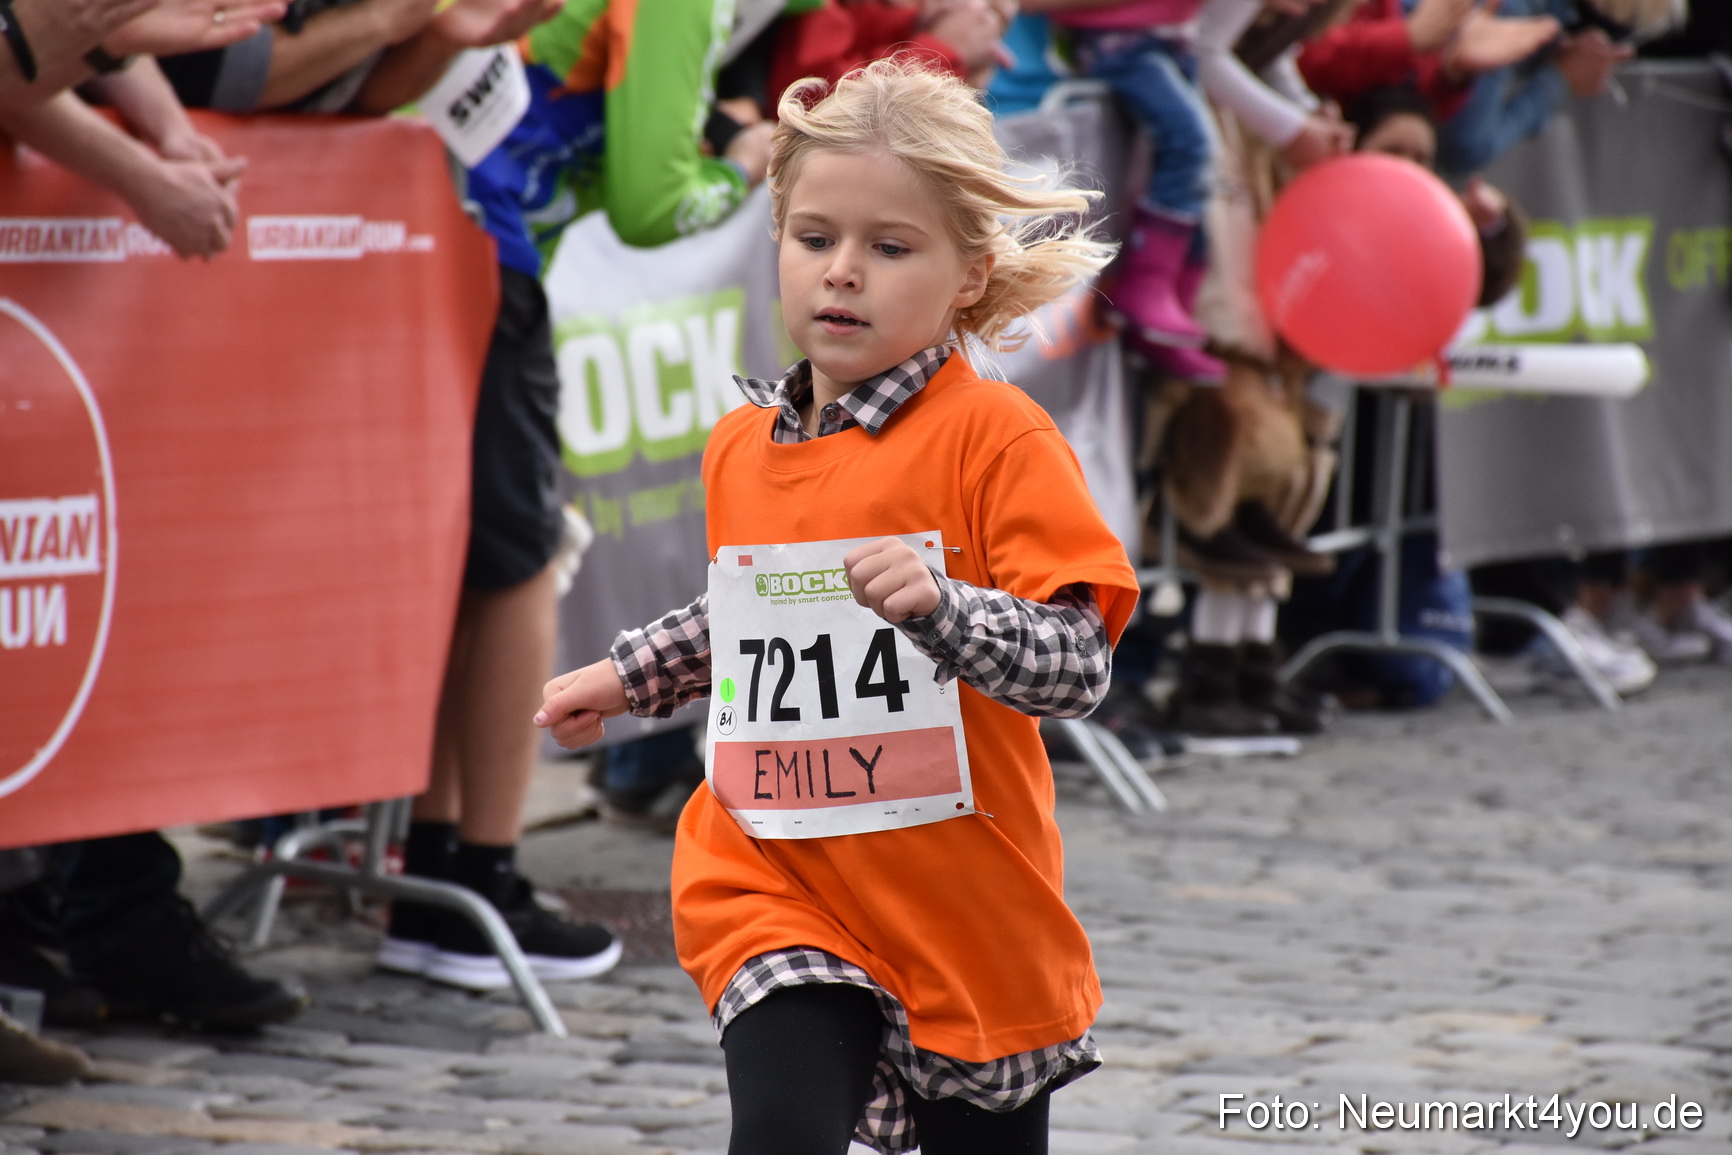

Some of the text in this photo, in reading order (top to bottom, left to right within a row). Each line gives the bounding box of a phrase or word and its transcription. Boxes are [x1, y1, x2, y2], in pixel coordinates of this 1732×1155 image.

[557, 308, 748, 458] OCK
[769, 568, 850, 596] BOCK
[788, 597, 797, 605] by
[798, 595, 820, 604] smart
[739, 628, 910, 722] 7214
[754, 744, 883, 800] EMILY
